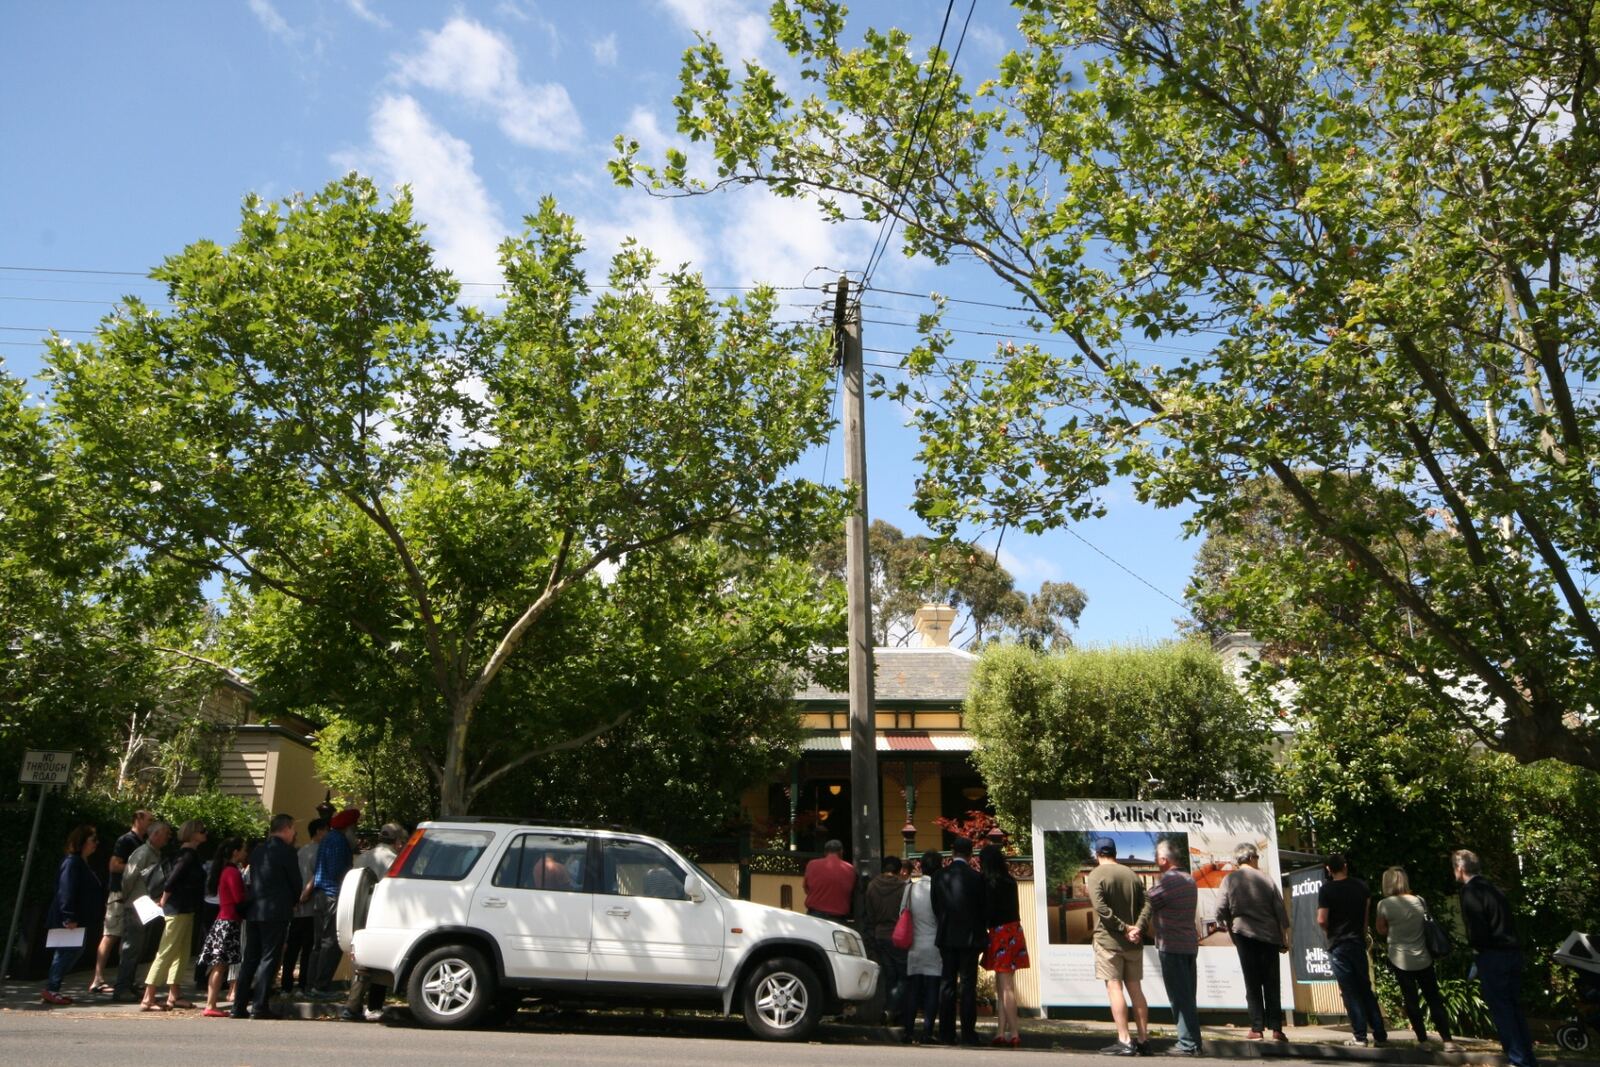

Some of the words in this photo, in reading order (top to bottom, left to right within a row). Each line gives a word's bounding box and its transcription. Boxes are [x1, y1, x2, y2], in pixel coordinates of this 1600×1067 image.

[42, 753, 56, 762] NO
[26, 761, 68, 773] THROUGH
[32, 771, 57, 781] ROAD
[1104, 806, 1204, 827] JellisCraig
[1305, 947, 1329, 961] Jellis
[1305, 960, 1334, 977] Craig
